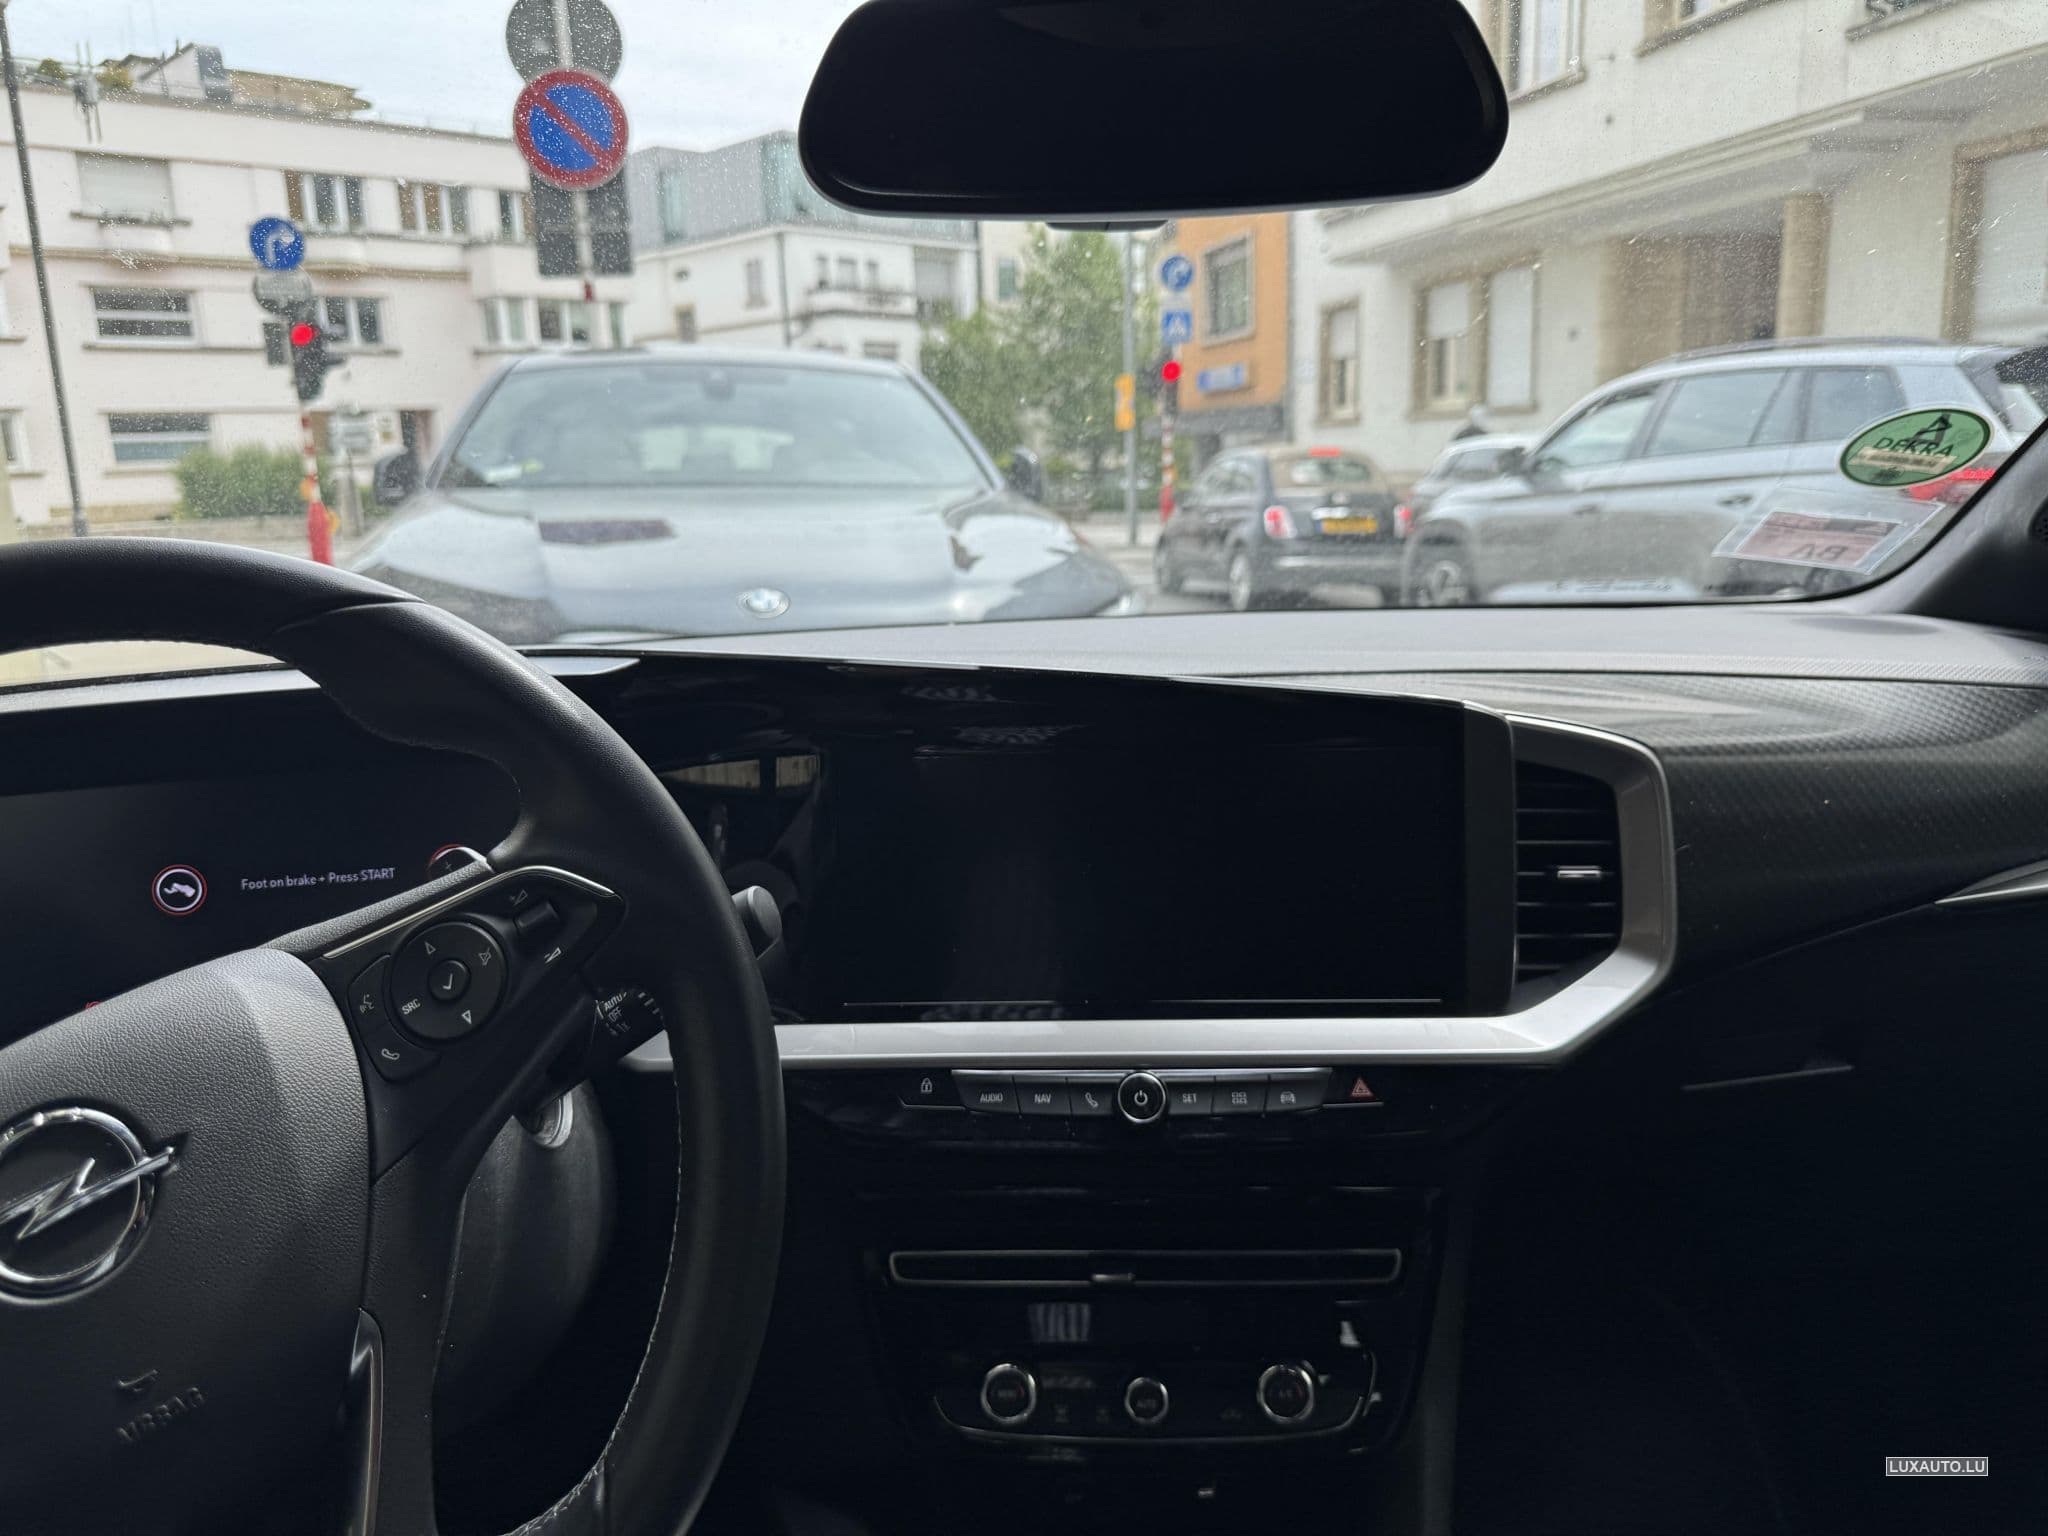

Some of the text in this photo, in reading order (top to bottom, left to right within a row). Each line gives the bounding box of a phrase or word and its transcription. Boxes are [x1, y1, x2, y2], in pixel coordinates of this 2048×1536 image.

[240, 878, 267, 891] Foot
[269, 880, 284, 888] on
[286, 875, 317, 887] brake
[328, 871, 358, 883] Press
[360, 867, 395, 881] START
[401, 998, 421, 1015] SRC
[980, 1092, 1004, 1104] AUDIO
[1034, 1093, 1052, 1104] NAV
[1182, 1093, 1197, 1104] SET
